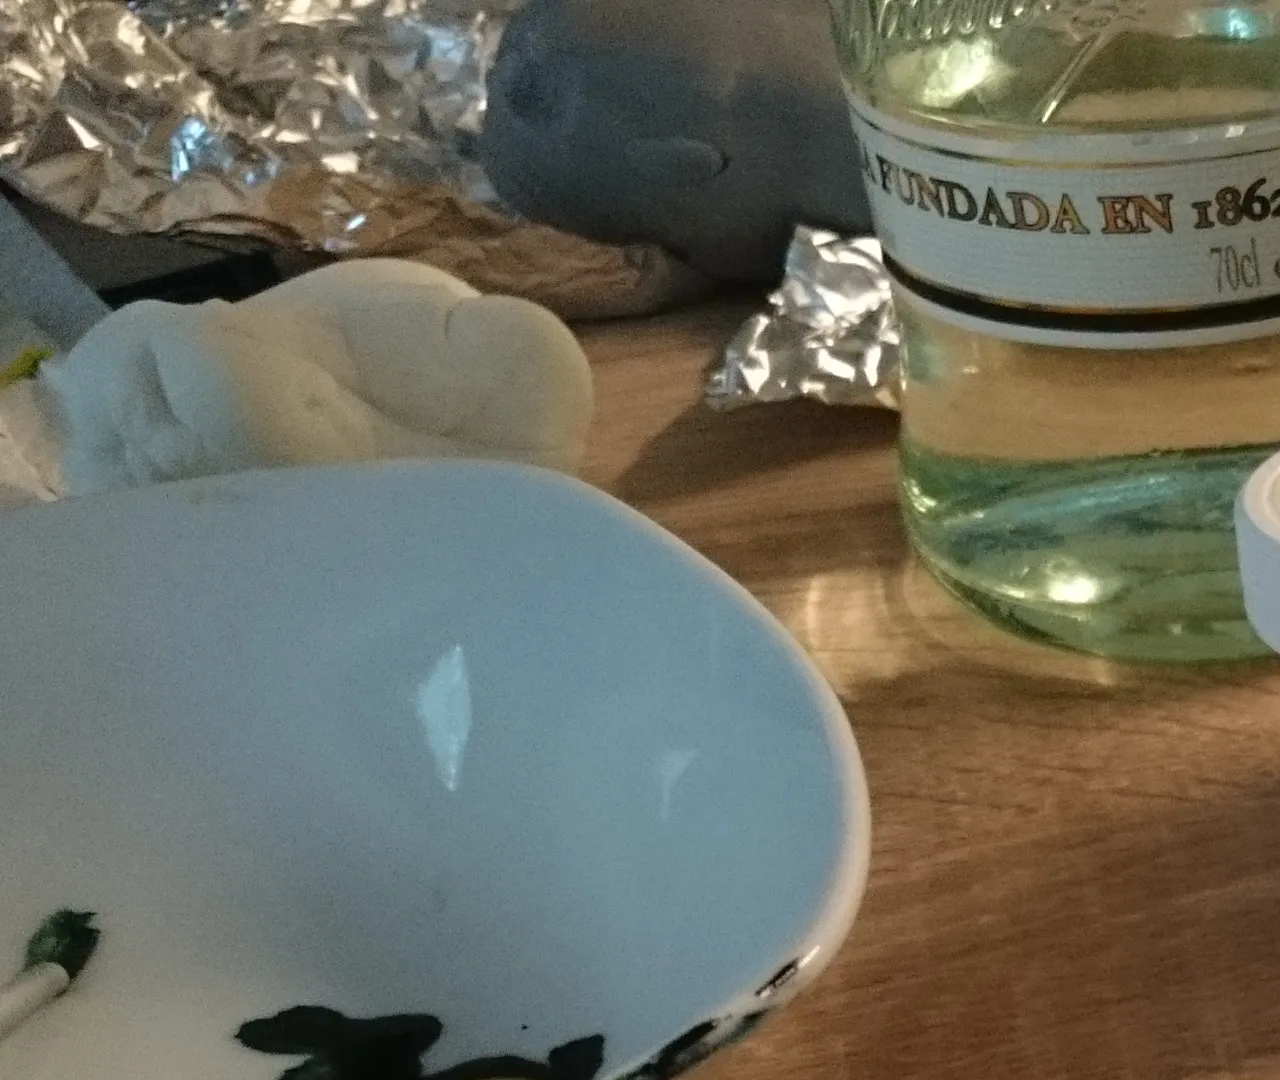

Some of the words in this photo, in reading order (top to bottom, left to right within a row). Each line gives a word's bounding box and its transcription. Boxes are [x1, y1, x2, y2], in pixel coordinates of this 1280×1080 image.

[875, 154, 1091, 235] FUNDADA
[1098, 193, 1174, 234] EN
[1209, 237, 1261, 292] 70cl
